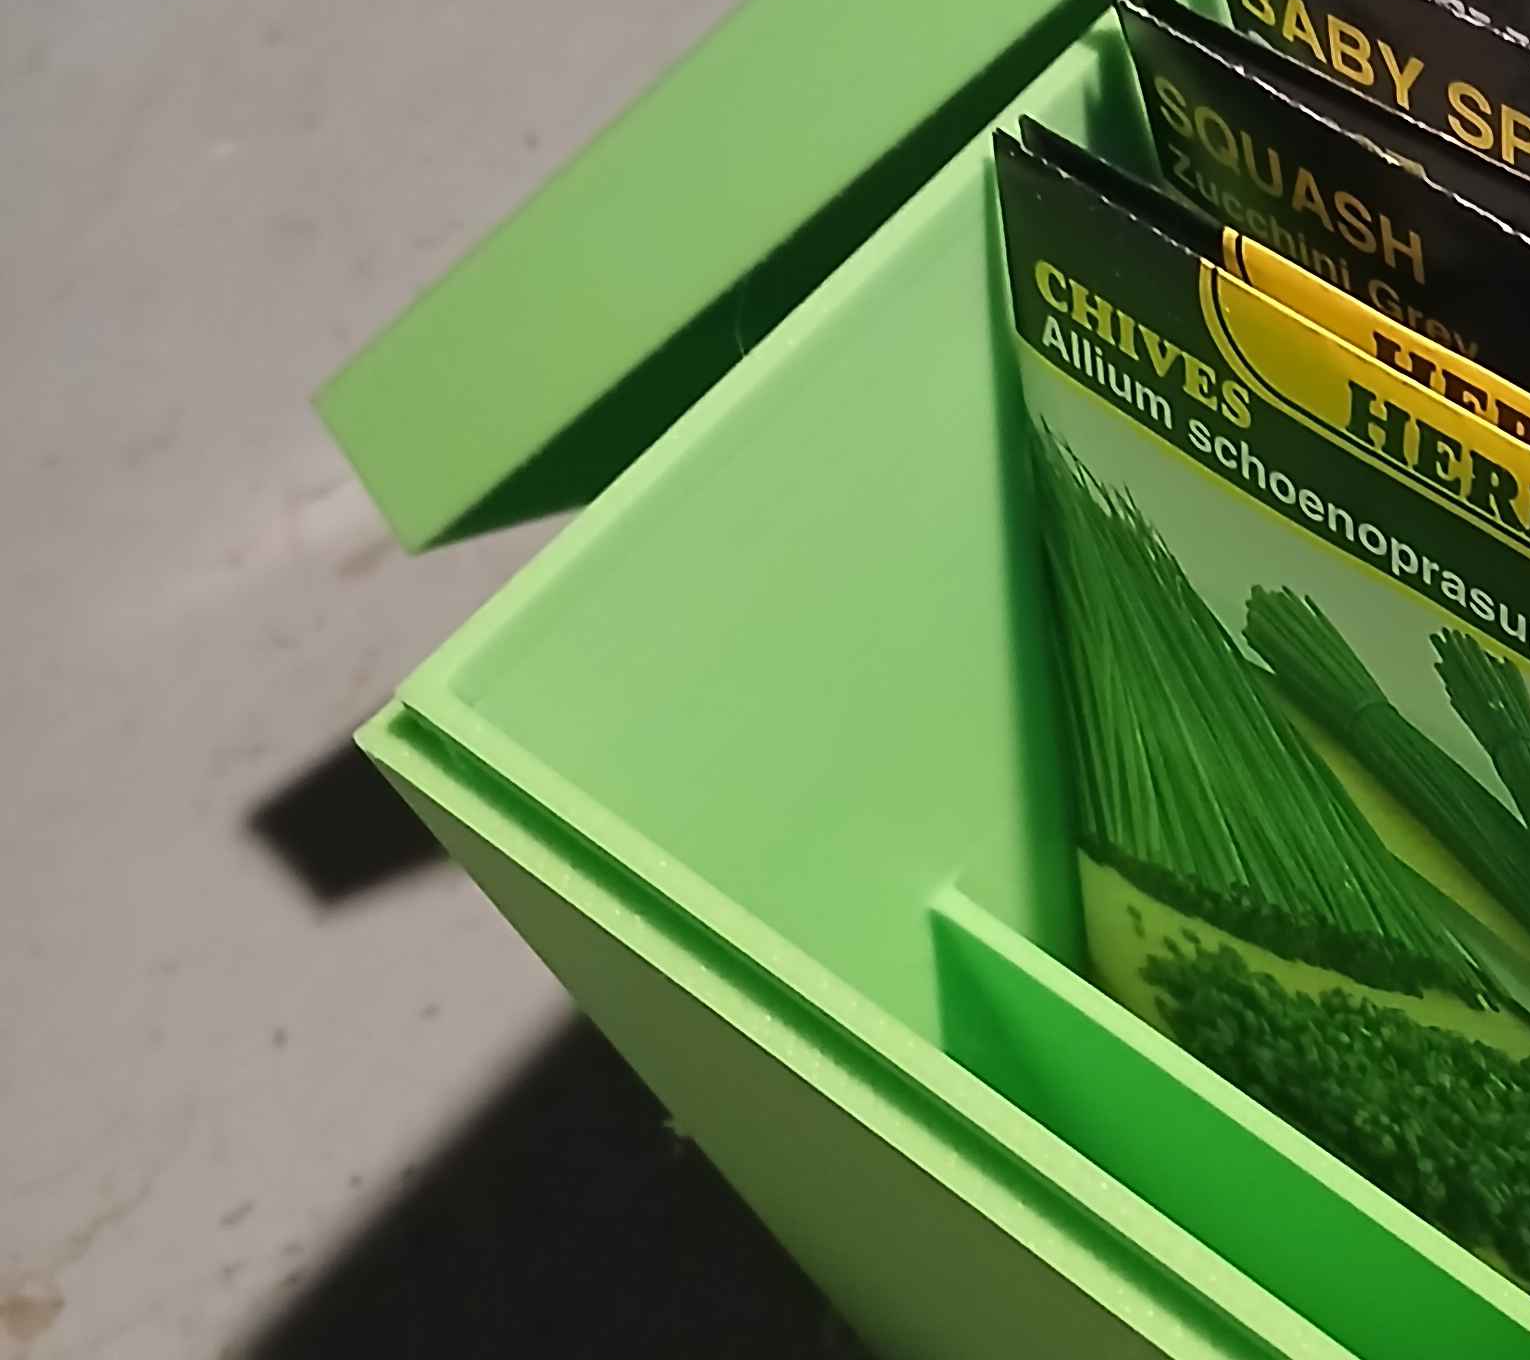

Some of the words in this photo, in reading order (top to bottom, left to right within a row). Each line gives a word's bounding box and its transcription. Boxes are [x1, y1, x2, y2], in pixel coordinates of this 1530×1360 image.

[1154, 76, 1427, 286] SQUASH
[1034, 260, 1252, 430] CHIVES
[1041, 314, 1174, 430] Allium
